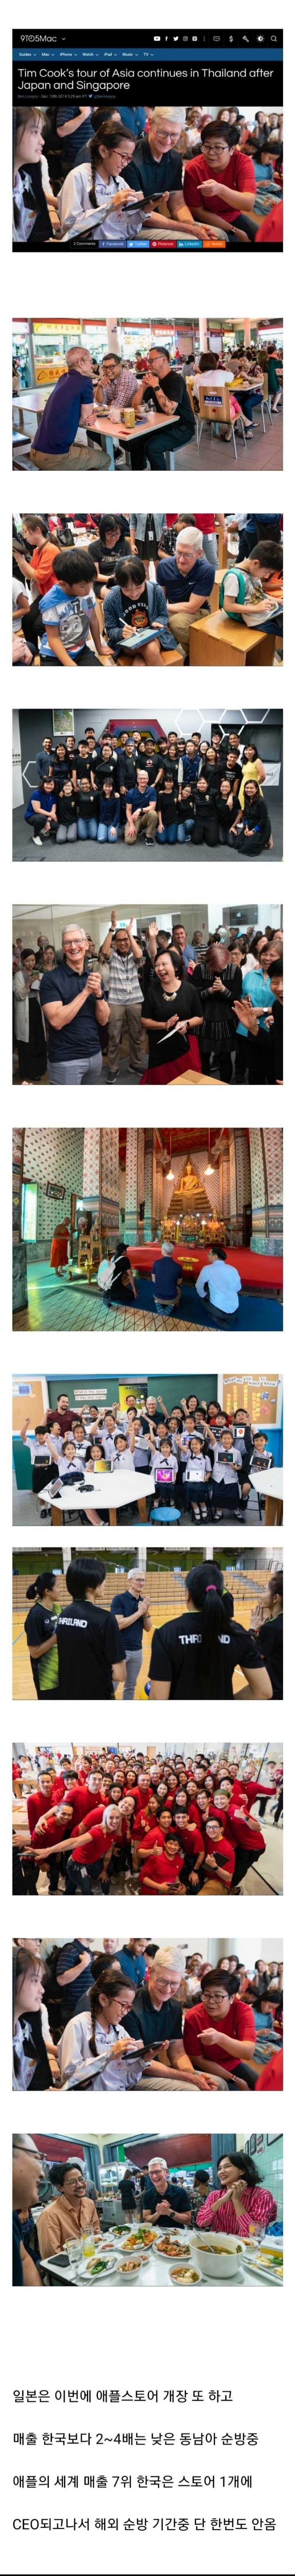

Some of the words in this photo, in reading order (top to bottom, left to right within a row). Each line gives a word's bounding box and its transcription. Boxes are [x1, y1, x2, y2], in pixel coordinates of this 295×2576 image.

[18, 69, 36, 77] Tim
[76, 69, 98, 78] tour
[100, 68, 110, 78] of
[112, 69, 134, 78] Asia
[137, 69, 188, 78] continues
[191, 69, 199, 77] in
[202, 68, 246, 78] Thailand
[249, 68, 274, 78] after
[18, 80, 51, 92] Japan
[53, 80, 74, 89] and
[76, 80, 130, 92] Singapore
[58, 1617, 88, 1628] THAILAND
[178, 1634, 230, 1645] THAIND
